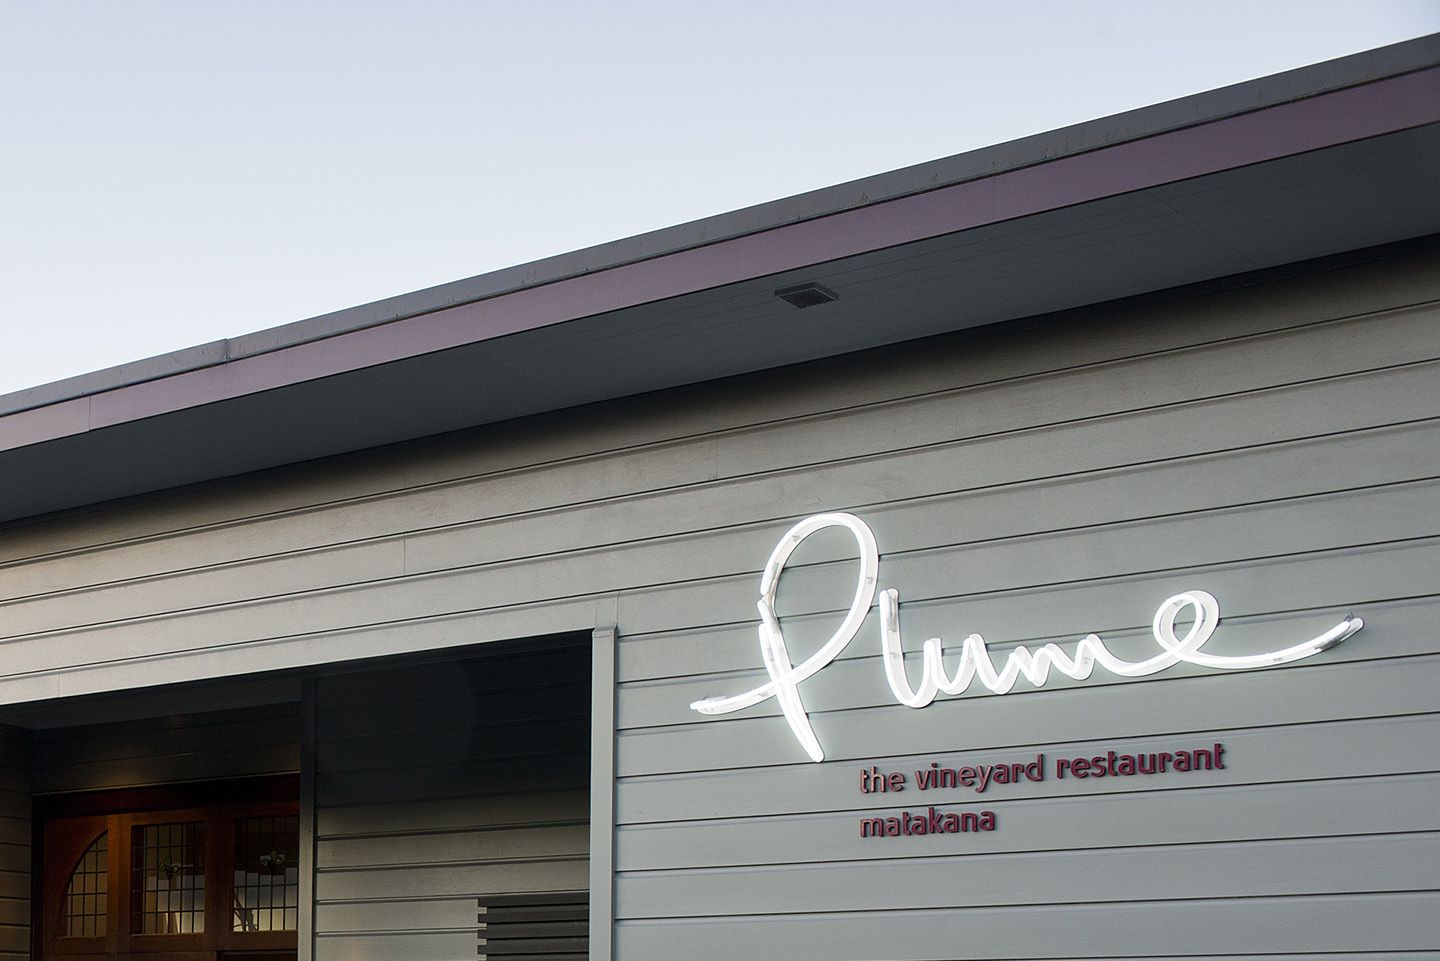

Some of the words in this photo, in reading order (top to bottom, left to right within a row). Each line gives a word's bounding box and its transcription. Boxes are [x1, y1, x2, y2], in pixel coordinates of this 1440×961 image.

[860, 767, 906, 794] the
[914, 753, 1045, 793] vineyard
[1055, 742, 1225, 780] restaurant
[860, 806, 996, 838] matakana
